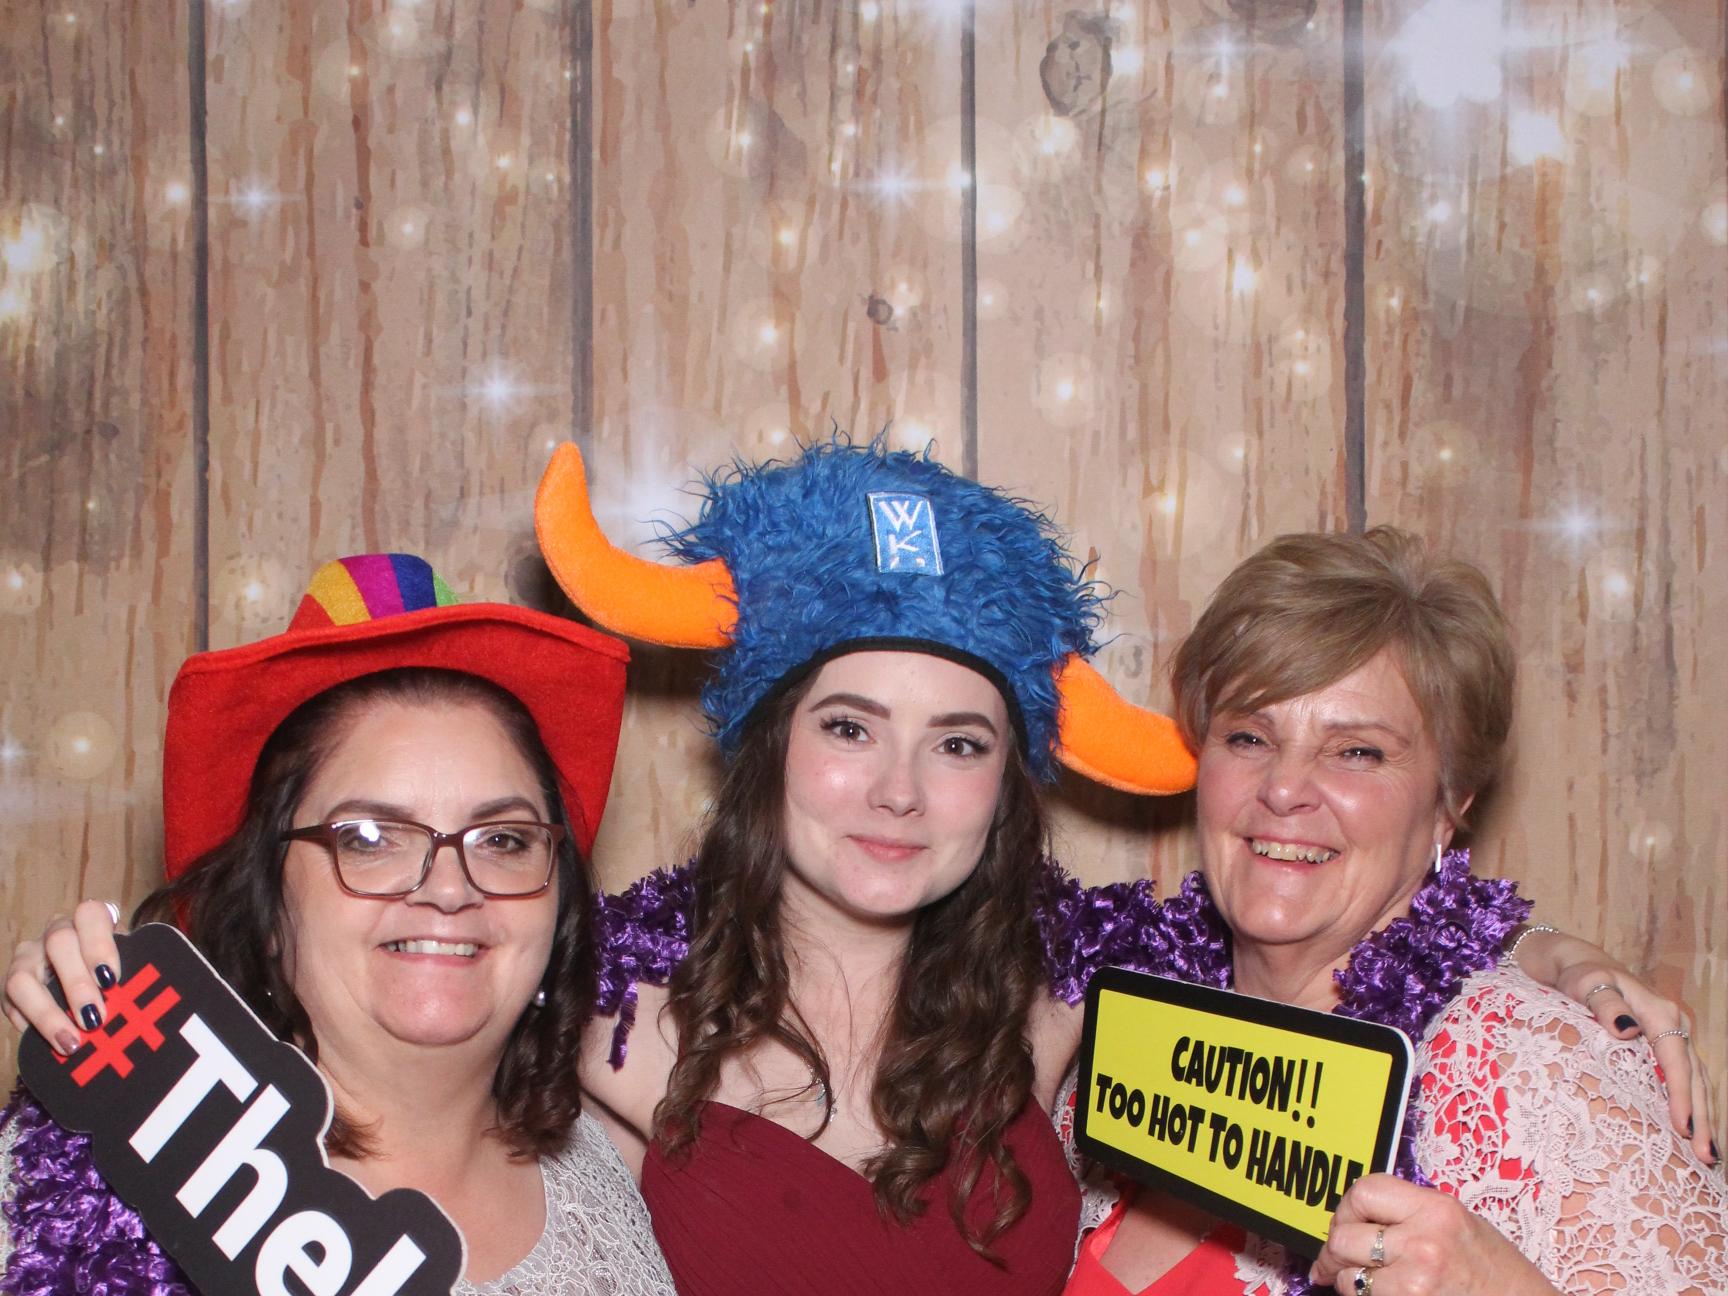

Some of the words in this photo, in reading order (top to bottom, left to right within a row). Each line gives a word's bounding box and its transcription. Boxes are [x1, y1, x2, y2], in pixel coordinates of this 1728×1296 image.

[1096, 1072, 1146, 1128] TOO
[1147, 1093, 1206, 1154] HOT
[1208, 1112, 1244, 1170] TO
[1171, 1036, 1324, 1129] CAUTION!!
